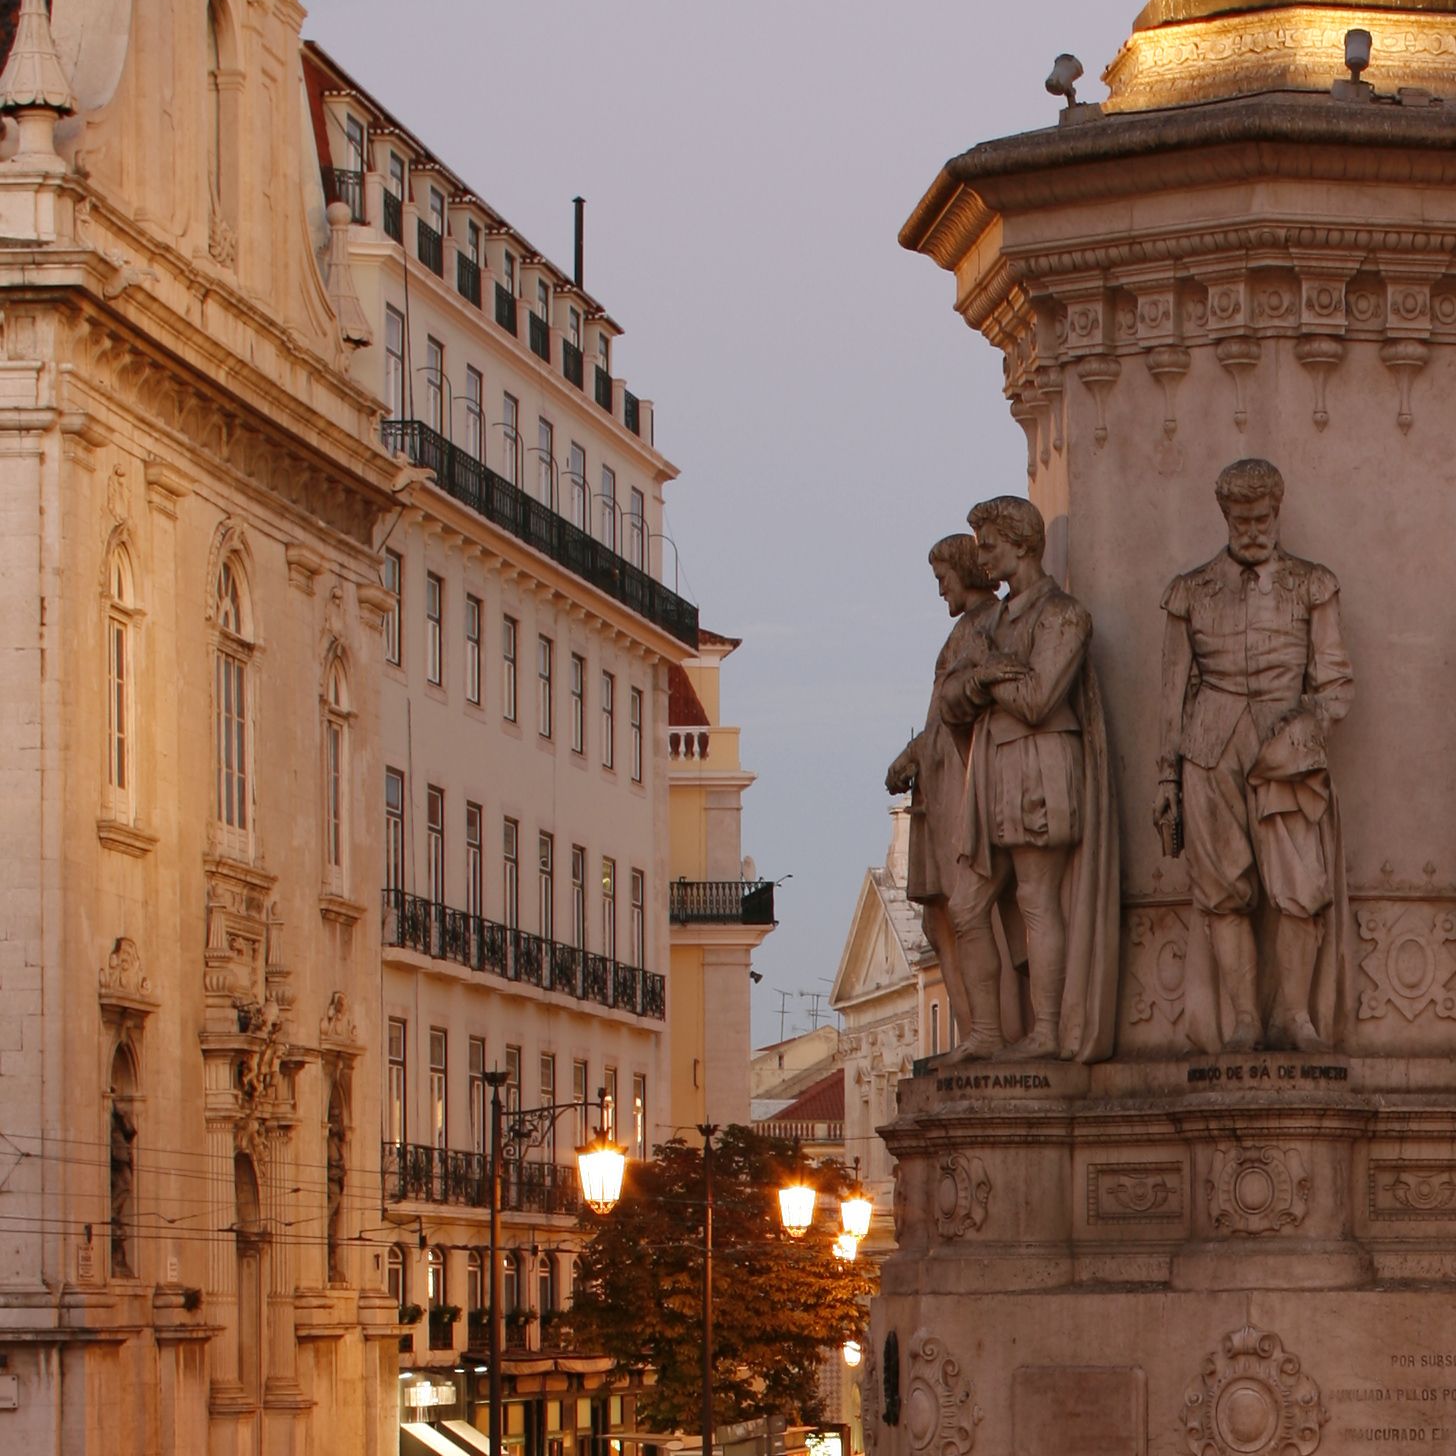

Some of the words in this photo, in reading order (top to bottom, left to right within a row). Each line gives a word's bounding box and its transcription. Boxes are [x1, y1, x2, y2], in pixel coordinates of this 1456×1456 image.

[1226, 1066, 1244, 1079] DE
[1278, 1066, 1296, 1079] DE
[956, 1074, 1051, 1089] CASTANHEDA
[1391, 1354, 1416, 1368] POR
